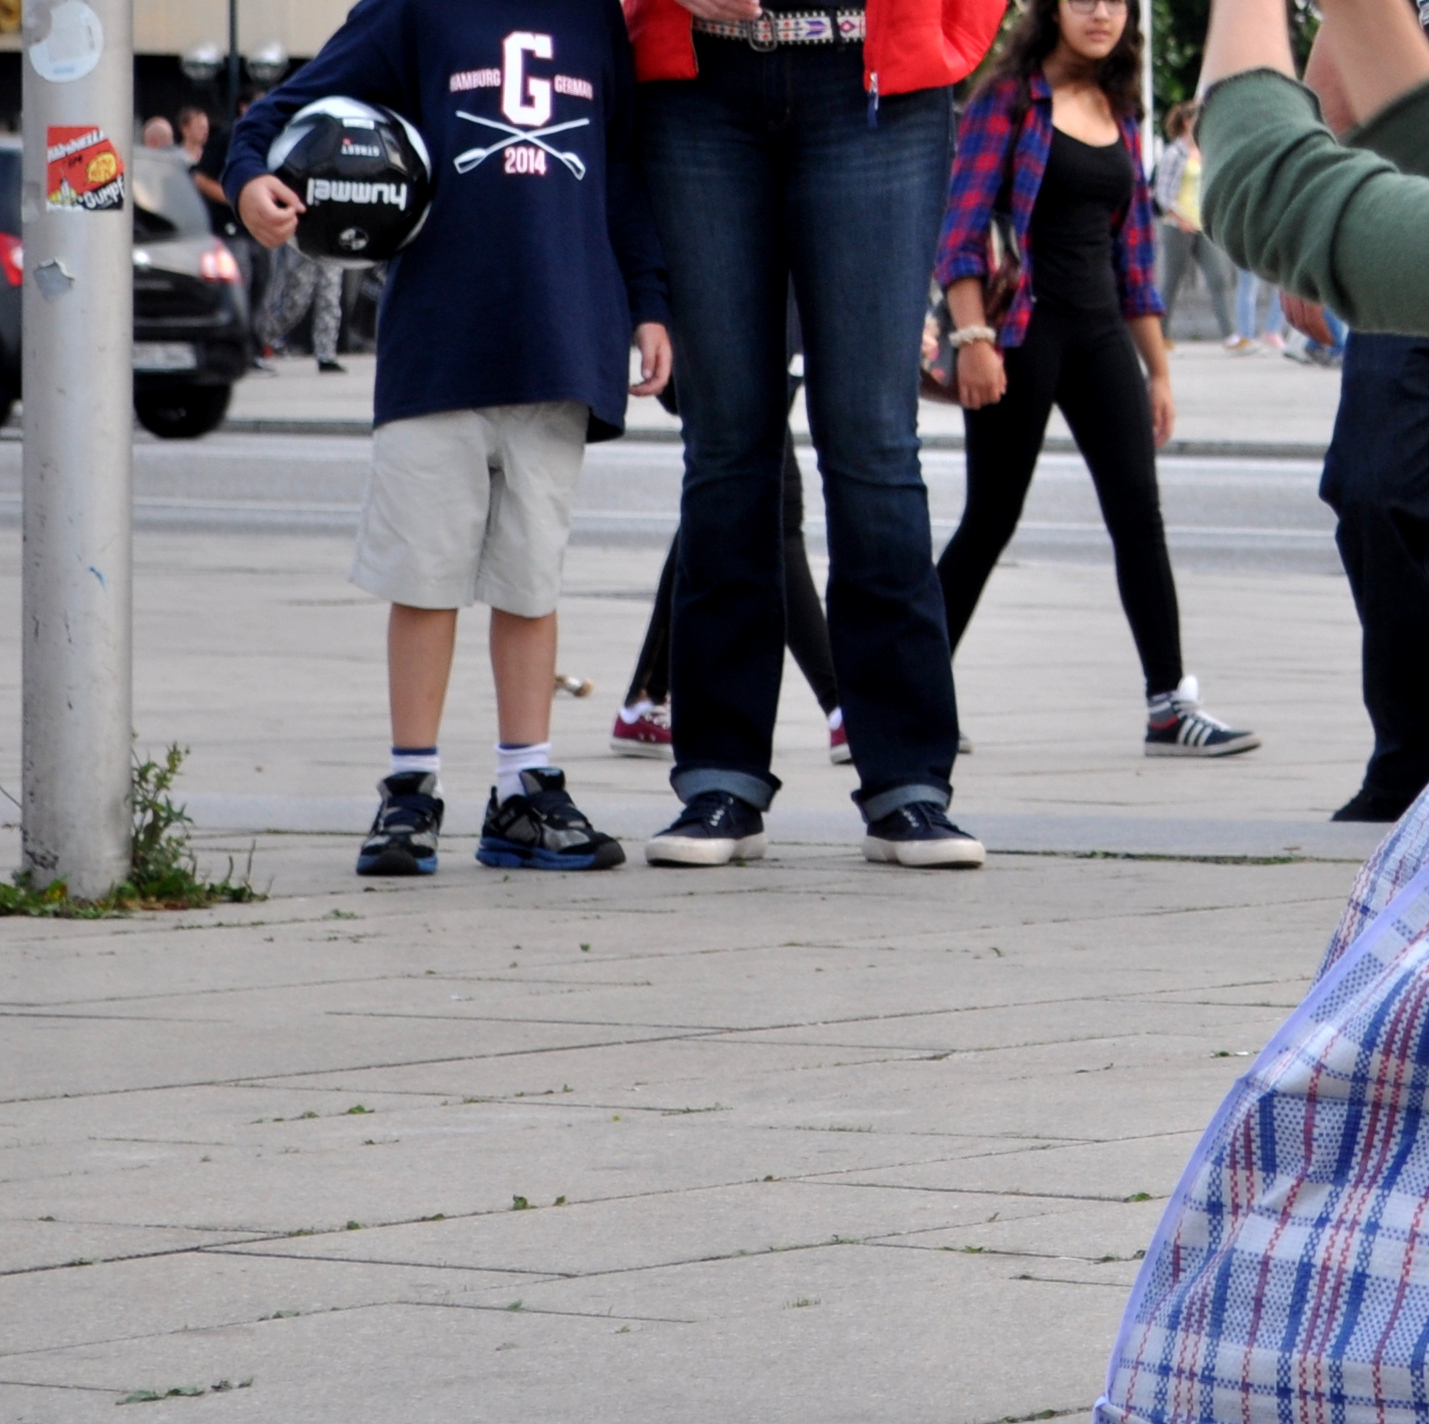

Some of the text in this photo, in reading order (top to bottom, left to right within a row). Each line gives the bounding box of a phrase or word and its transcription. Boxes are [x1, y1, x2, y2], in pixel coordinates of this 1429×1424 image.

[450, 68, 501, 93] HAMBURG
[502, 31, 552, 127] G
[504, 146, 547, 175] 2014
[307, 178, 407, 211] hummel
